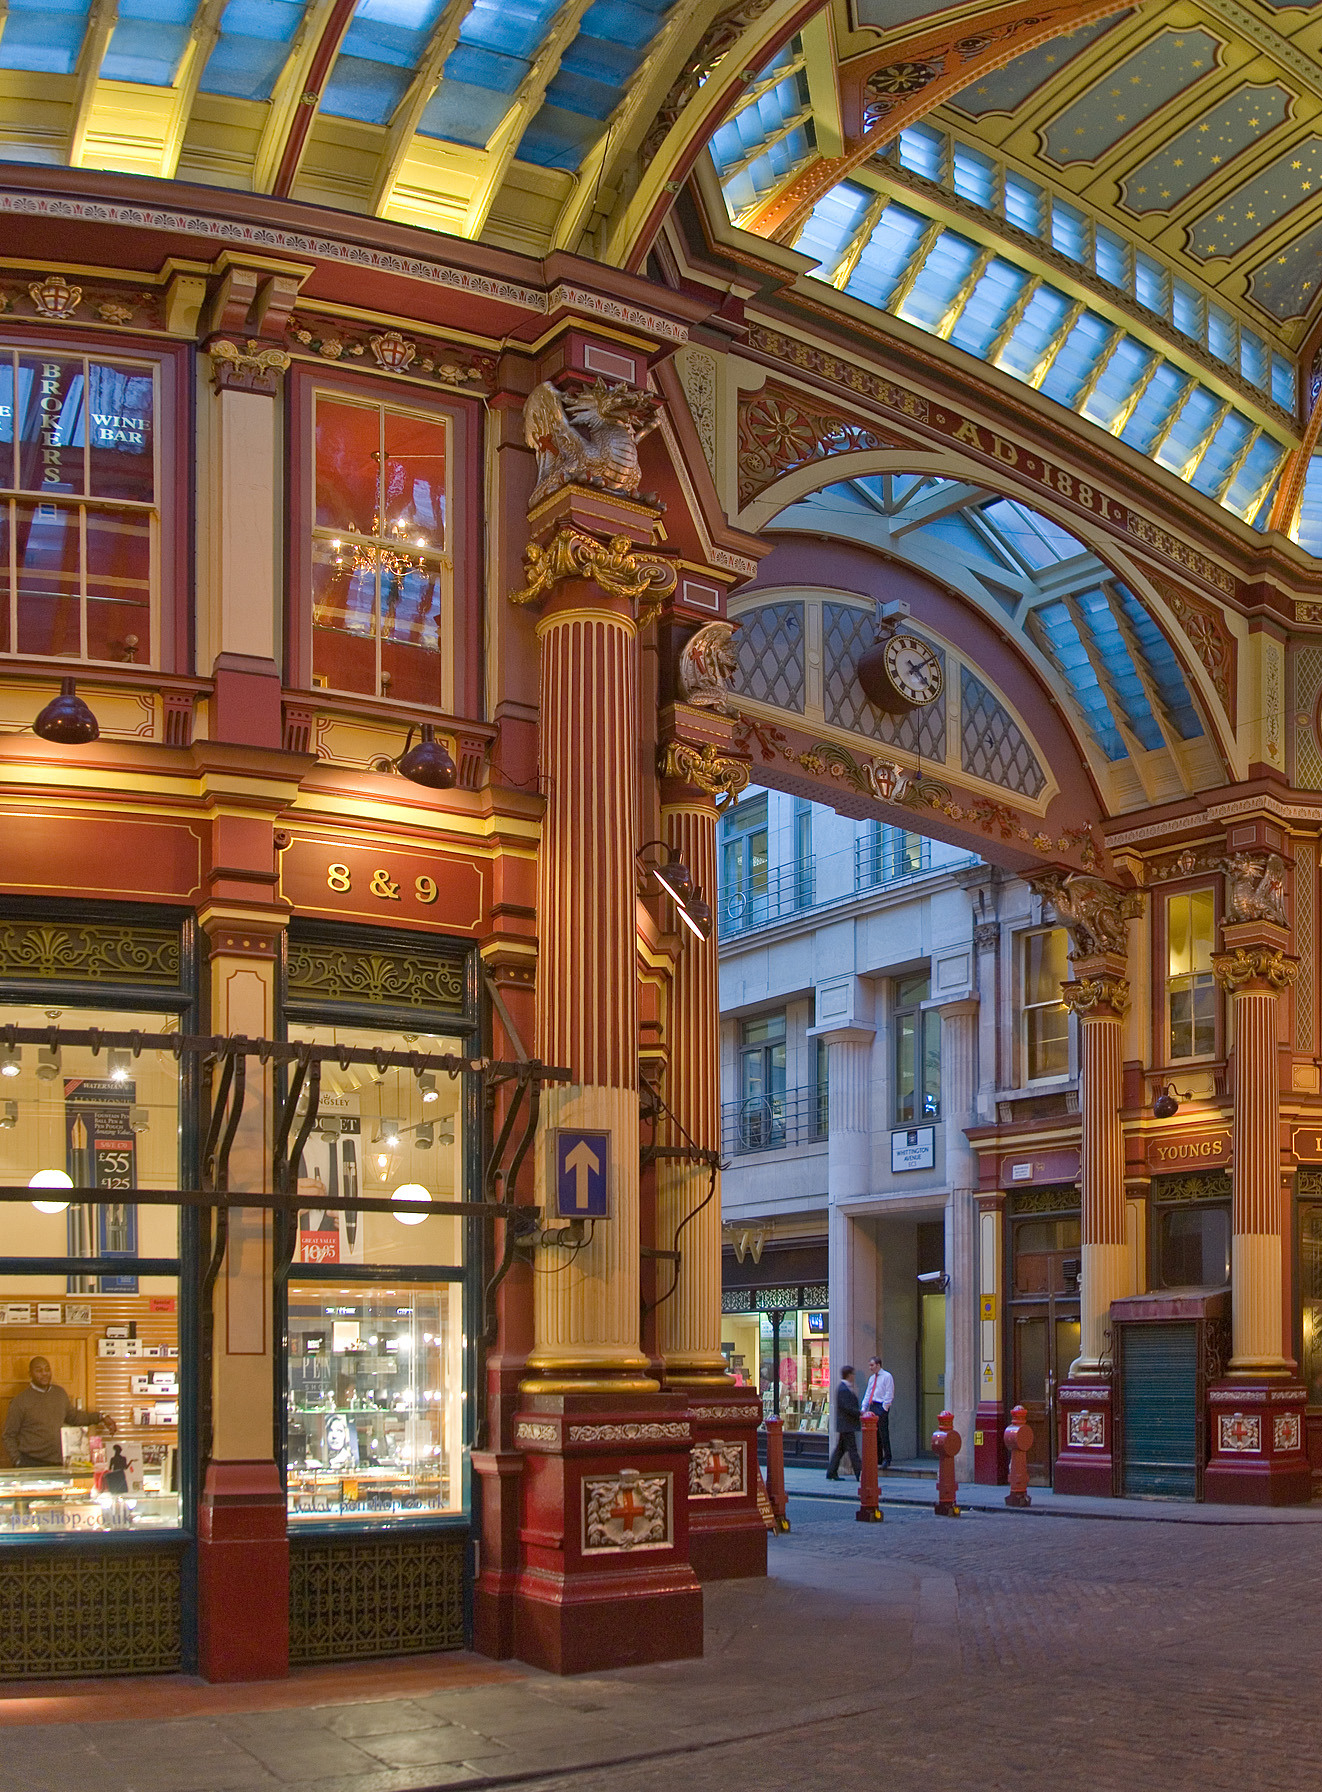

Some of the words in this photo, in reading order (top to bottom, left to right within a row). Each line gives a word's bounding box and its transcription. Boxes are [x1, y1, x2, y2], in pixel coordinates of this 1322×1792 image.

[41, 363, 63, 483] BROKERS
[92, 413, 151, 431] WINE
[100, 428, 143, 443] BAR
[1041, 460, 1111, 520] 1881
[327, 863, 351, 892] 8
[369, 869, 399, 899] &
[415, 875, 438, 903] 9
[897, 1146, 929, 1156] WHITTINGTON
[904, 1153, 922, 1161] AVENUE
[1157, 1140, 1223, 1160] YOUNGS
[98, 1152, 130, 1173] £55
[101, 1177, 130, 1189] £125
[302, 1357, 331, 1379] PEN
